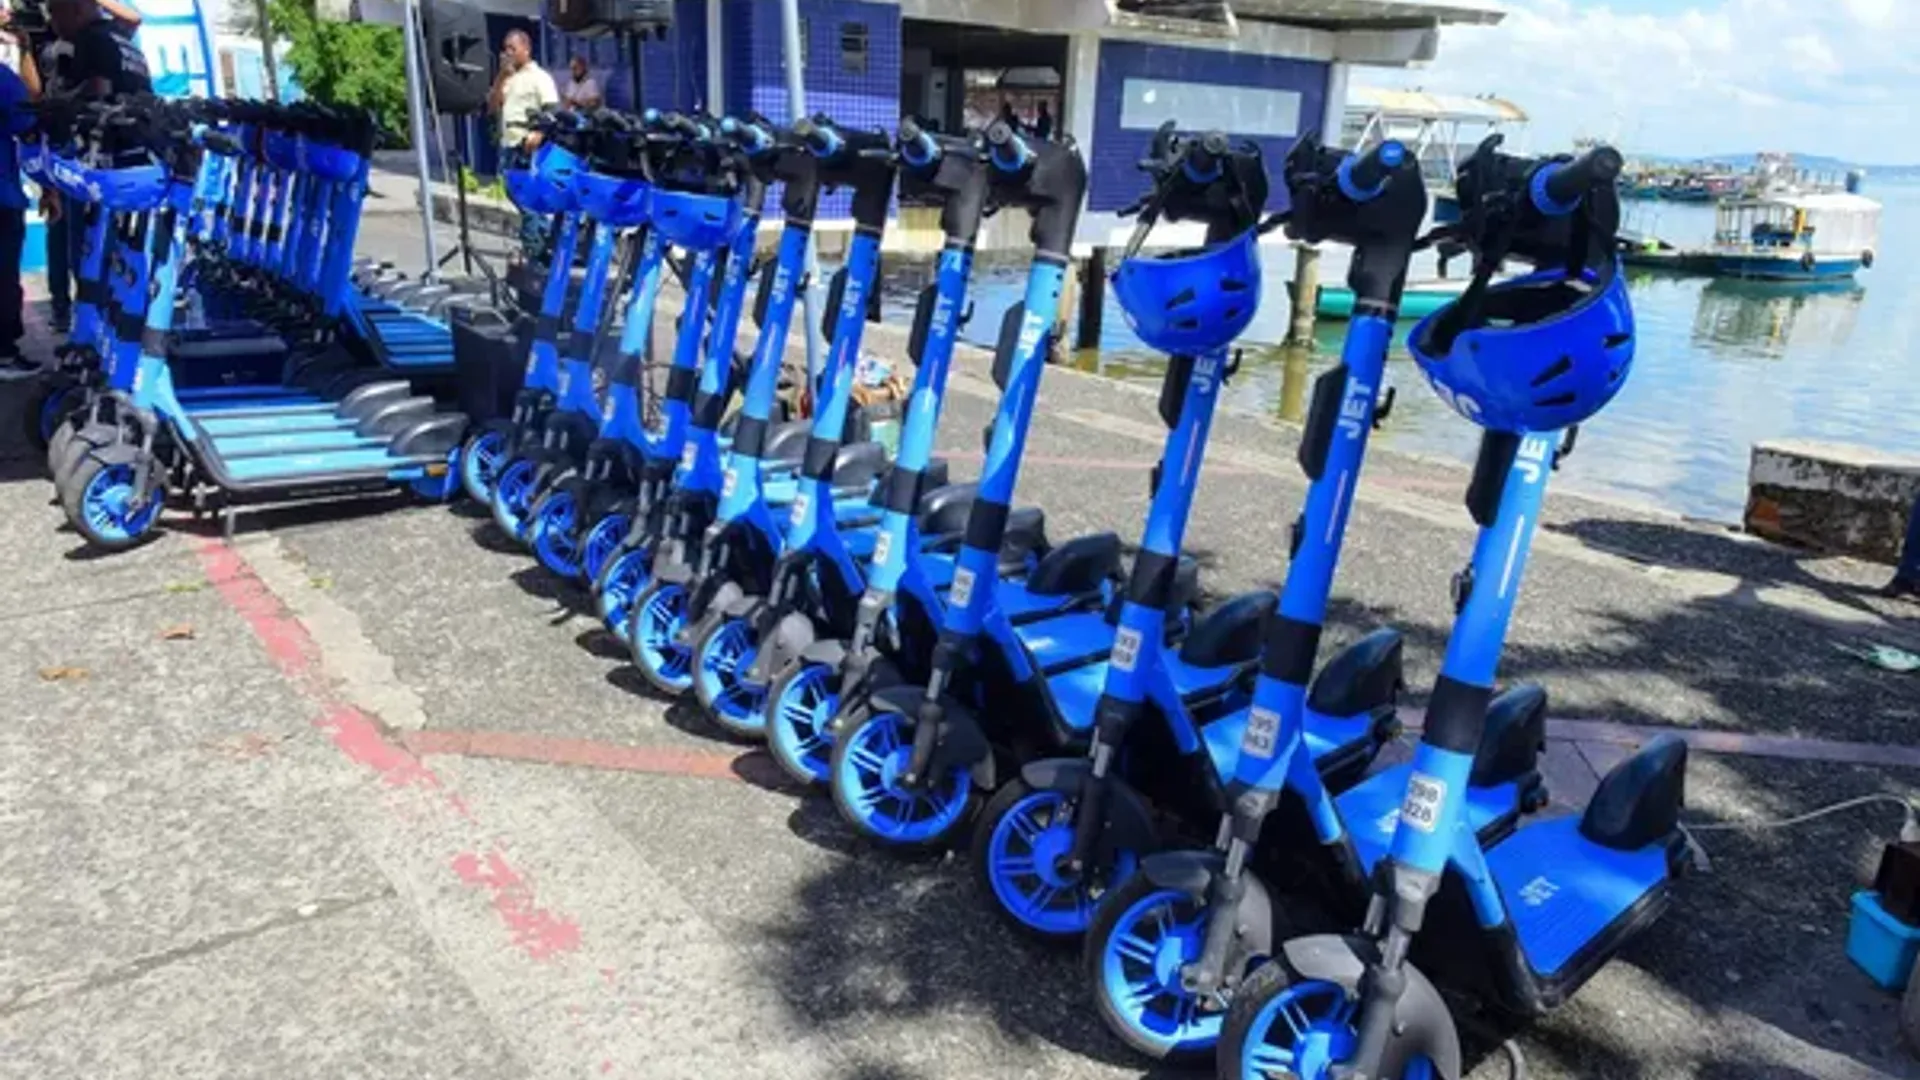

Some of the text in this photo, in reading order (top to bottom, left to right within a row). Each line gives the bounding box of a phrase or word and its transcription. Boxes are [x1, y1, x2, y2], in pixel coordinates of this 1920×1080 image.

[772, 264, 791, 304] JET
[841, 276, 862, 318] JET
[931, 291, 954, 337] JET
[1018, 308, 1044, 359] JET
[1191, 355, 1217, 394] JE
[1337, 376, 1371, 439] JET
[1513, 437, 1549, 484] JE
